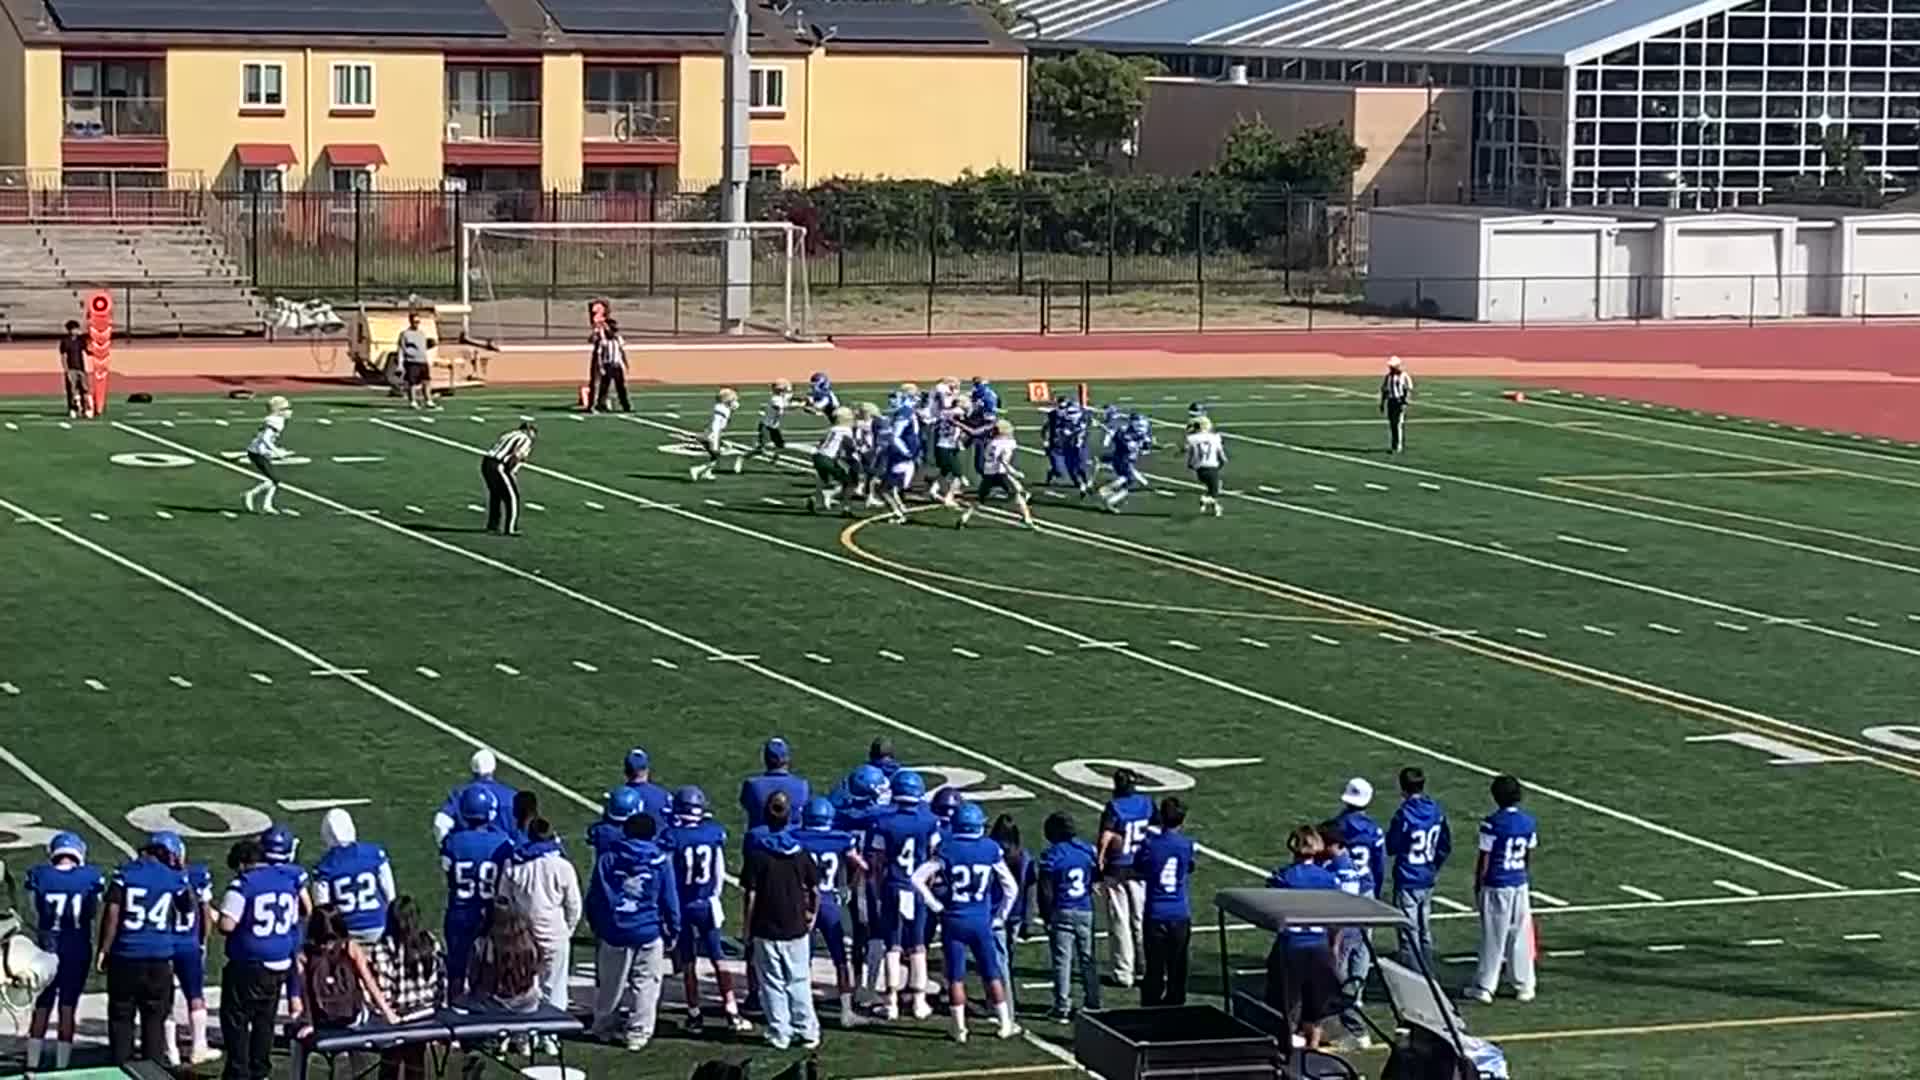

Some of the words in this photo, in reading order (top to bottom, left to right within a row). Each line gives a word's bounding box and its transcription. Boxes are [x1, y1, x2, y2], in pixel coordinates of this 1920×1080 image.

[685, 844, 712, 885] 13
[897, 836, 915, 876] 4
[1408, 824, 1441, 865] 20
[334, 872, 381, 912] 52
[951, 863, 992, 902] 27
[1067, 867, 1085, 897] 3
[45, 893, 83, 931] 71
[124, 887, 172, 930] 54
[253, 892, 294, 937] 53
